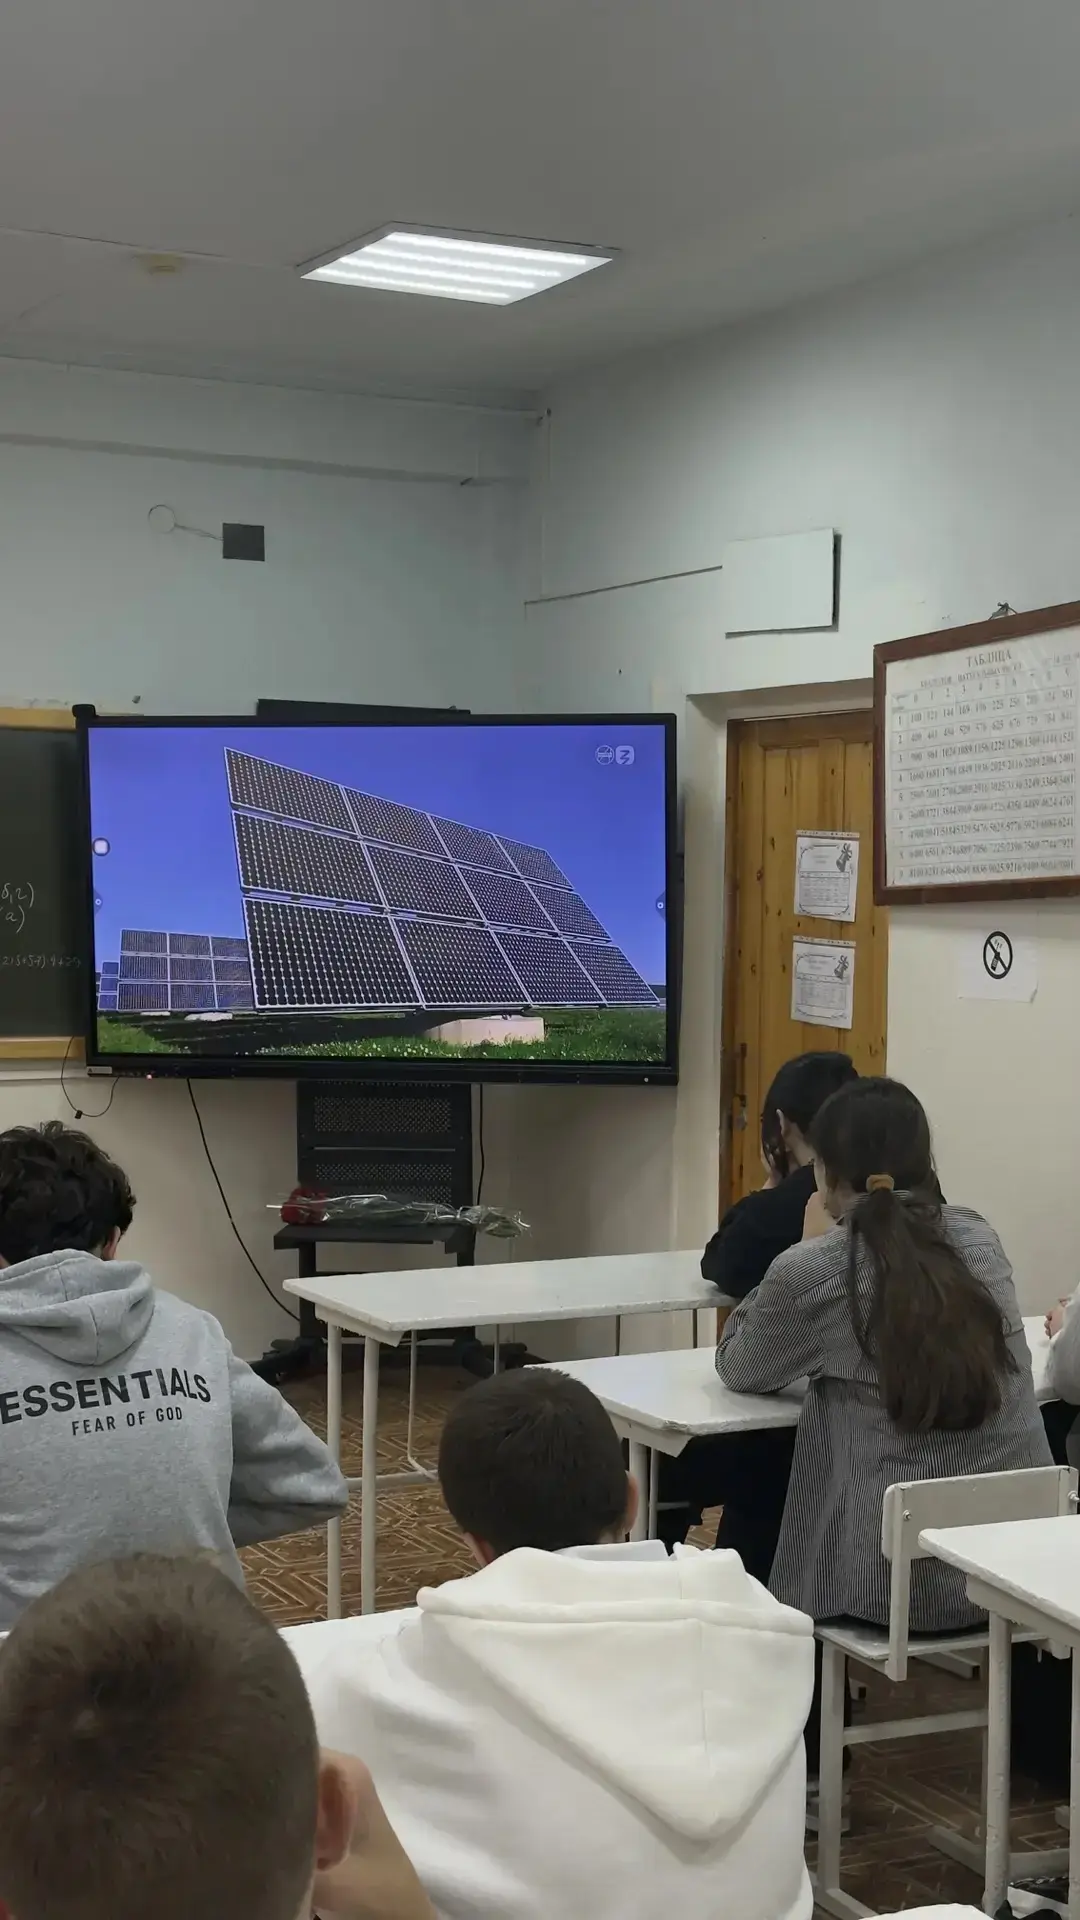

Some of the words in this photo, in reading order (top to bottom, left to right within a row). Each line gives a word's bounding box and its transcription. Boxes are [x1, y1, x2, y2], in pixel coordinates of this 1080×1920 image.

[966, 649, 1012, 667] ТАБЛИЦА
[1008, 696, 1021, 708] 25
[1006, 799, 1022, 810] 435
[989, 821, 1005, 833] 562
[1023, 819, 1039, 830] 592
[989, 842, 1005, 853] 225
[1058, 837, 1074, 849] 921
[0, 1367, 211, 1424] ESSENTIALS
[72, 1416, 116, 1436] FEAR
[127, 1411, 146, 1426] OF
[156, 1407, 183, 1422] GOD
